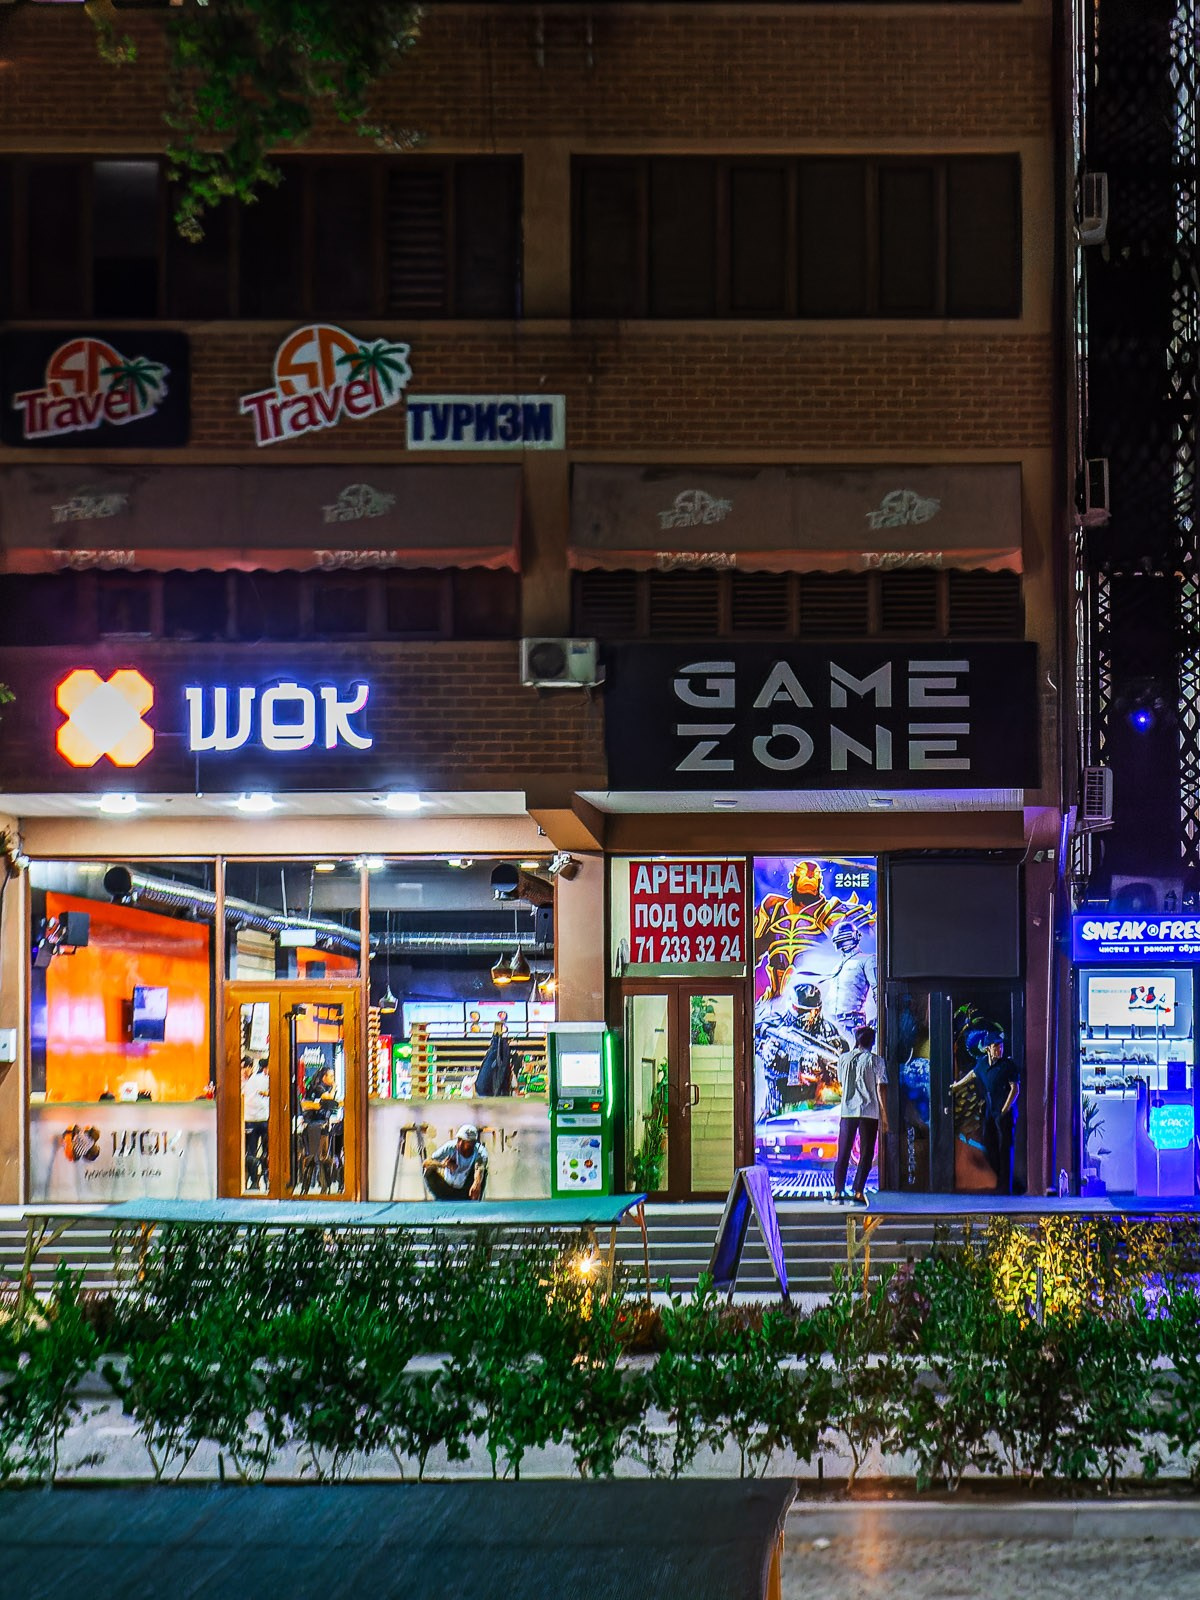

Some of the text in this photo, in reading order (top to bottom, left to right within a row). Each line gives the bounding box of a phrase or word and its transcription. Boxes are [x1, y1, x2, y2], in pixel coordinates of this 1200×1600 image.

[17, 378, 138, 433] Travel
[244, 366, 384, 441] Travel
[408, 403, 552, 442] ТУРИЗМ
[674, 660, 970, 708] GAME
[186, 683, 373, 751] WOK
[675, 723, 970, 771] ZONE
[634, 864, 741, 899] АРЕНДА
[635, 902, 741, 932] ПОД ОФИС
[1082, 921, 1146, 940] SNEAK
[635, 935, 741, 962] 71 233 32 24
[1144, 945, 1174, 954] ремонт
